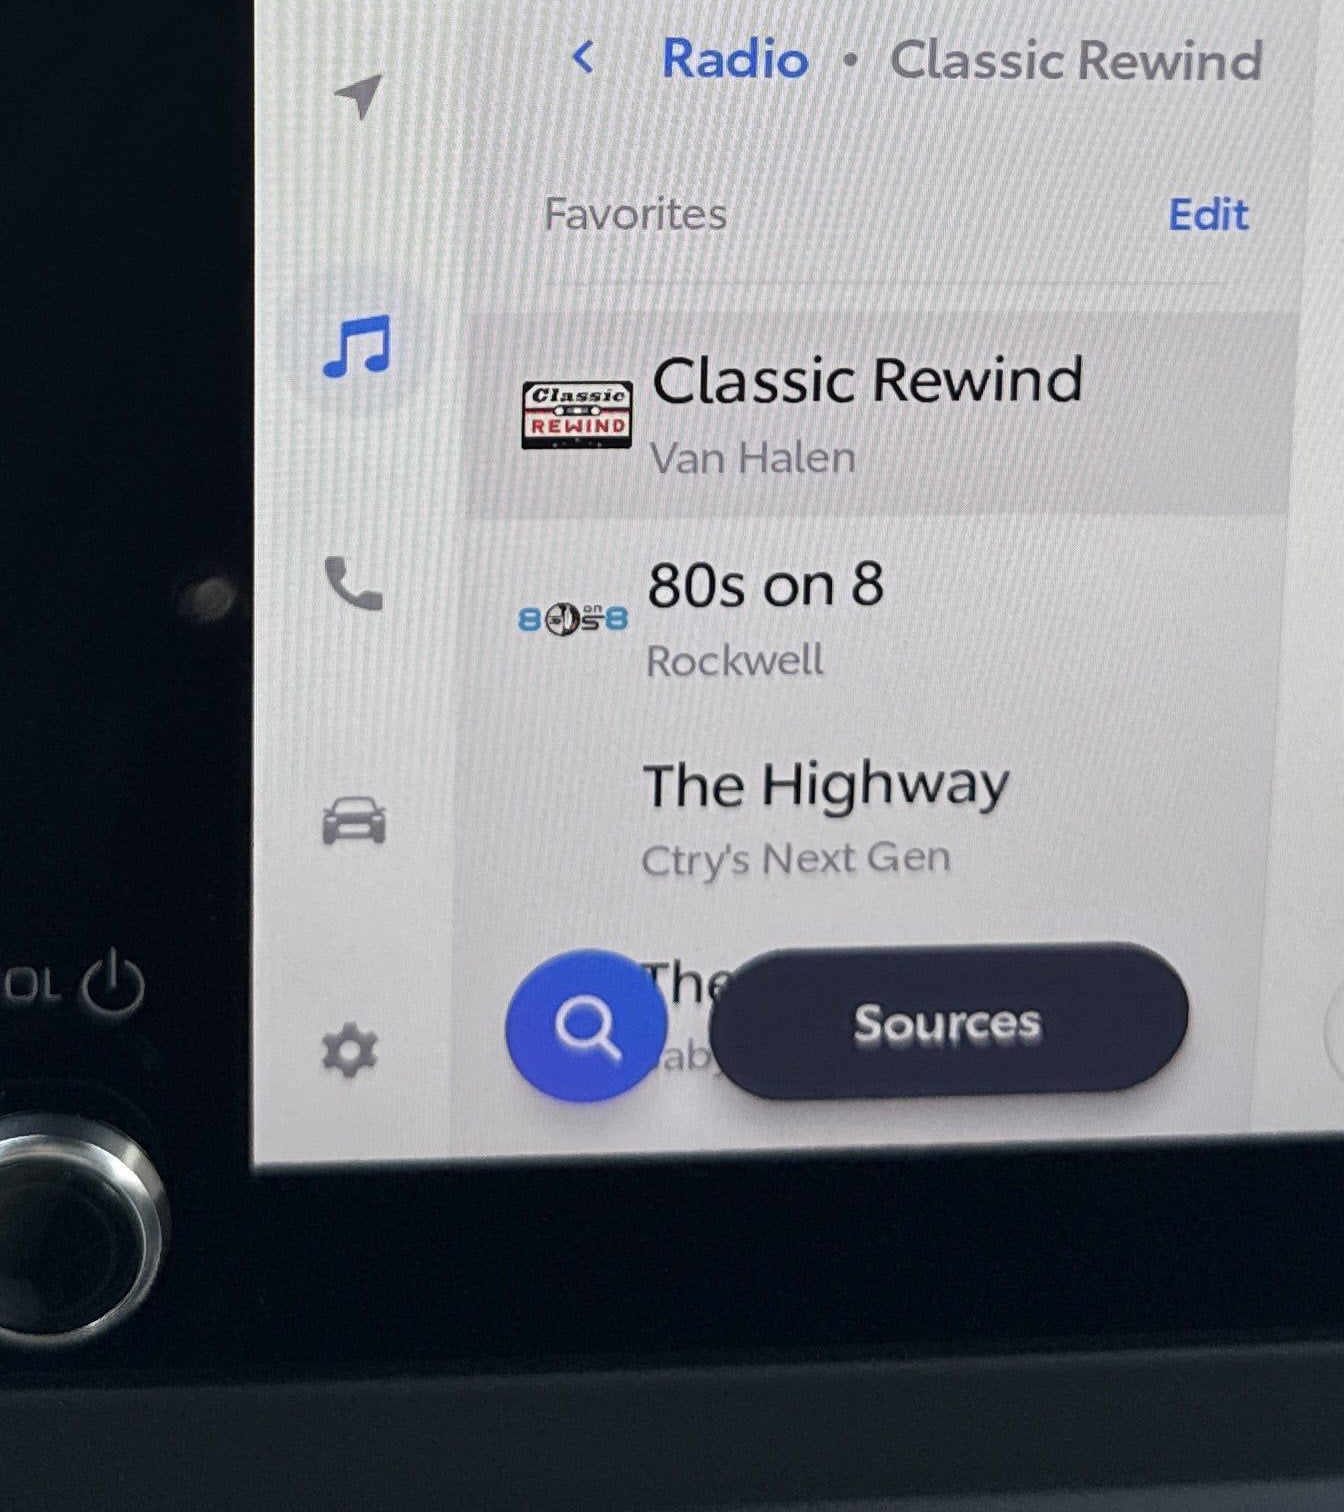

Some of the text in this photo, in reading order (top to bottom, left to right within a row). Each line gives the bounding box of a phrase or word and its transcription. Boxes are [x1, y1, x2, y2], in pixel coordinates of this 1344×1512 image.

[664, 36, 1263, 81] Radio Classic Rewind
[545, 195, 727, 231] Favorites
[1170, 196, 1249, 231] Edit
[531, 386, 627, 403] Classic
[653, 355, 1083, 404] Classic Rewind
[532, 419, 625, 434] REWIND
[650, 438, 856, 475] Van Halen
[649, 560, 884, 609] 80s on 8
[647, 642, 824, 678] Rockwell
[644, 760, 1009, 819] The Highway
[641, 840, 951, 886] Ctry's Next Gen
[856, 1004, 1041, 1044] Sources
